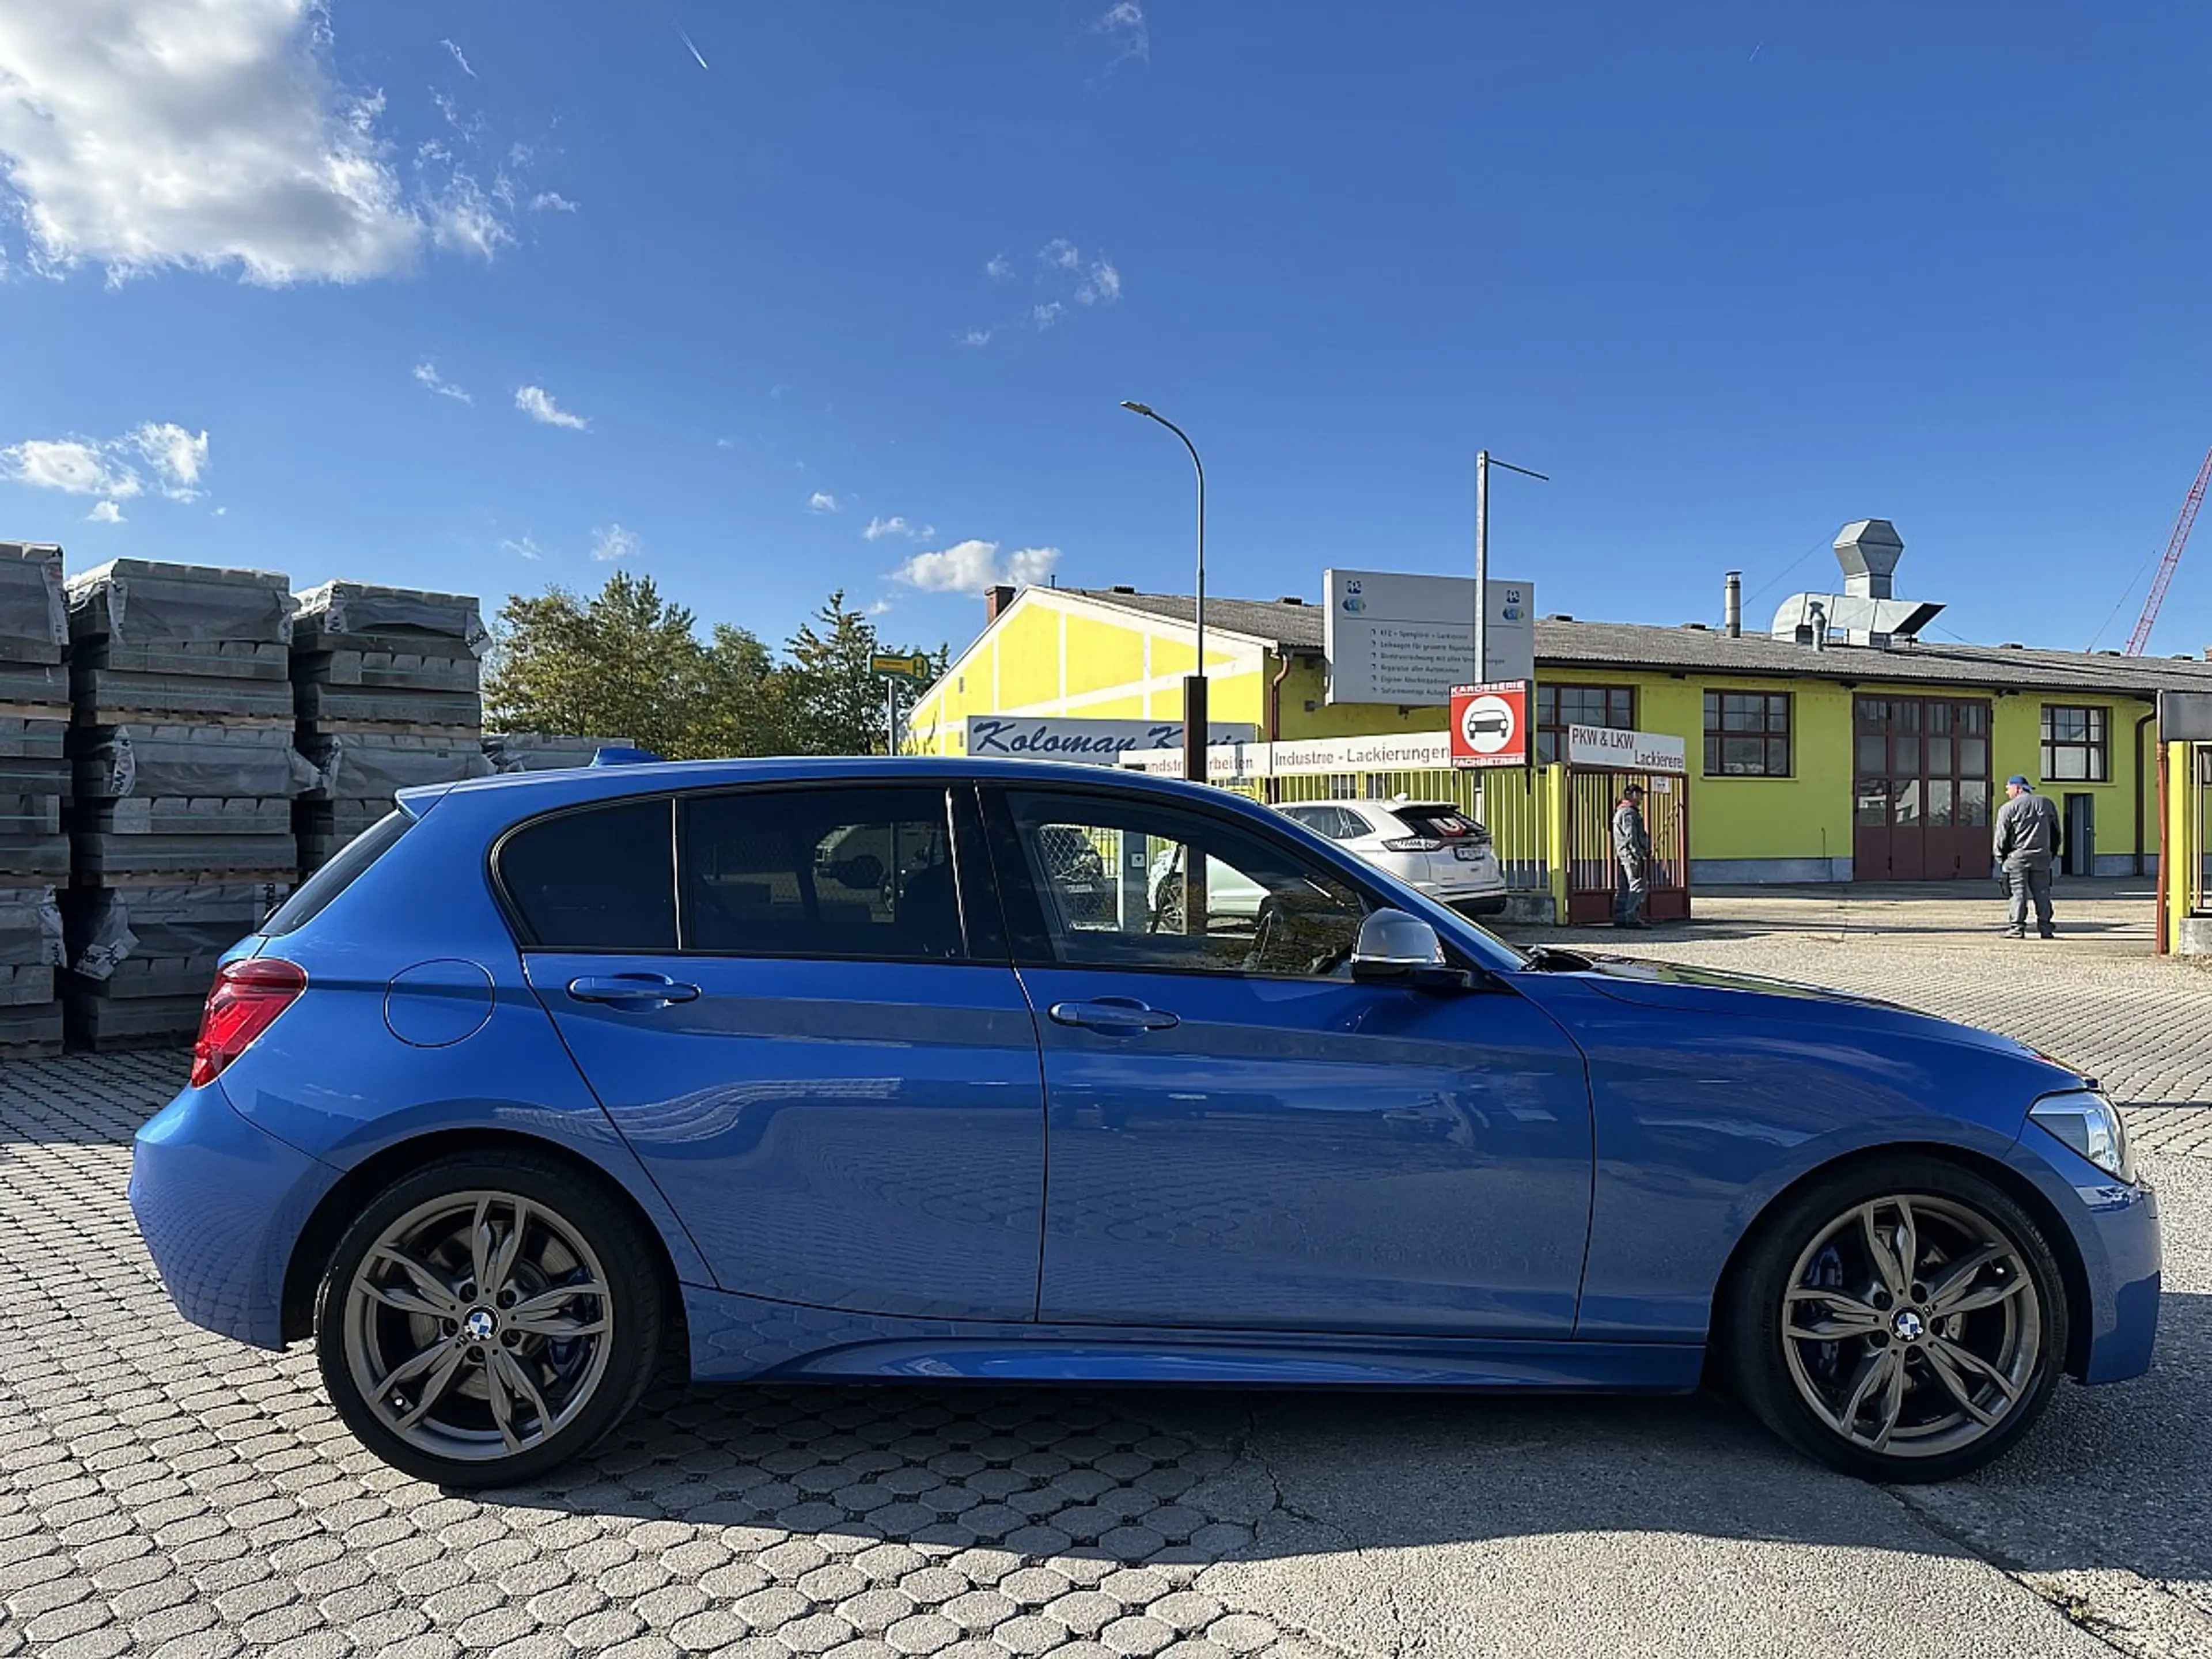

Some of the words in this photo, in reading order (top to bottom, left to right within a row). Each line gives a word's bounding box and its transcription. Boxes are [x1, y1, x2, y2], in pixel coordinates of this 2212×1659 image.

[973, 720, 1137, 753] Koloman
[1572, 728, 1598, 746] PKW
[1600, 730, 1609, 747] &
[1611, 732, 1635, 750] LKW
[1275, 751, 1334, 767] Industrie
[1347, 746, 1450, 764] Lackierungen
[1635, 749, 1685, 770] Lackiererei
